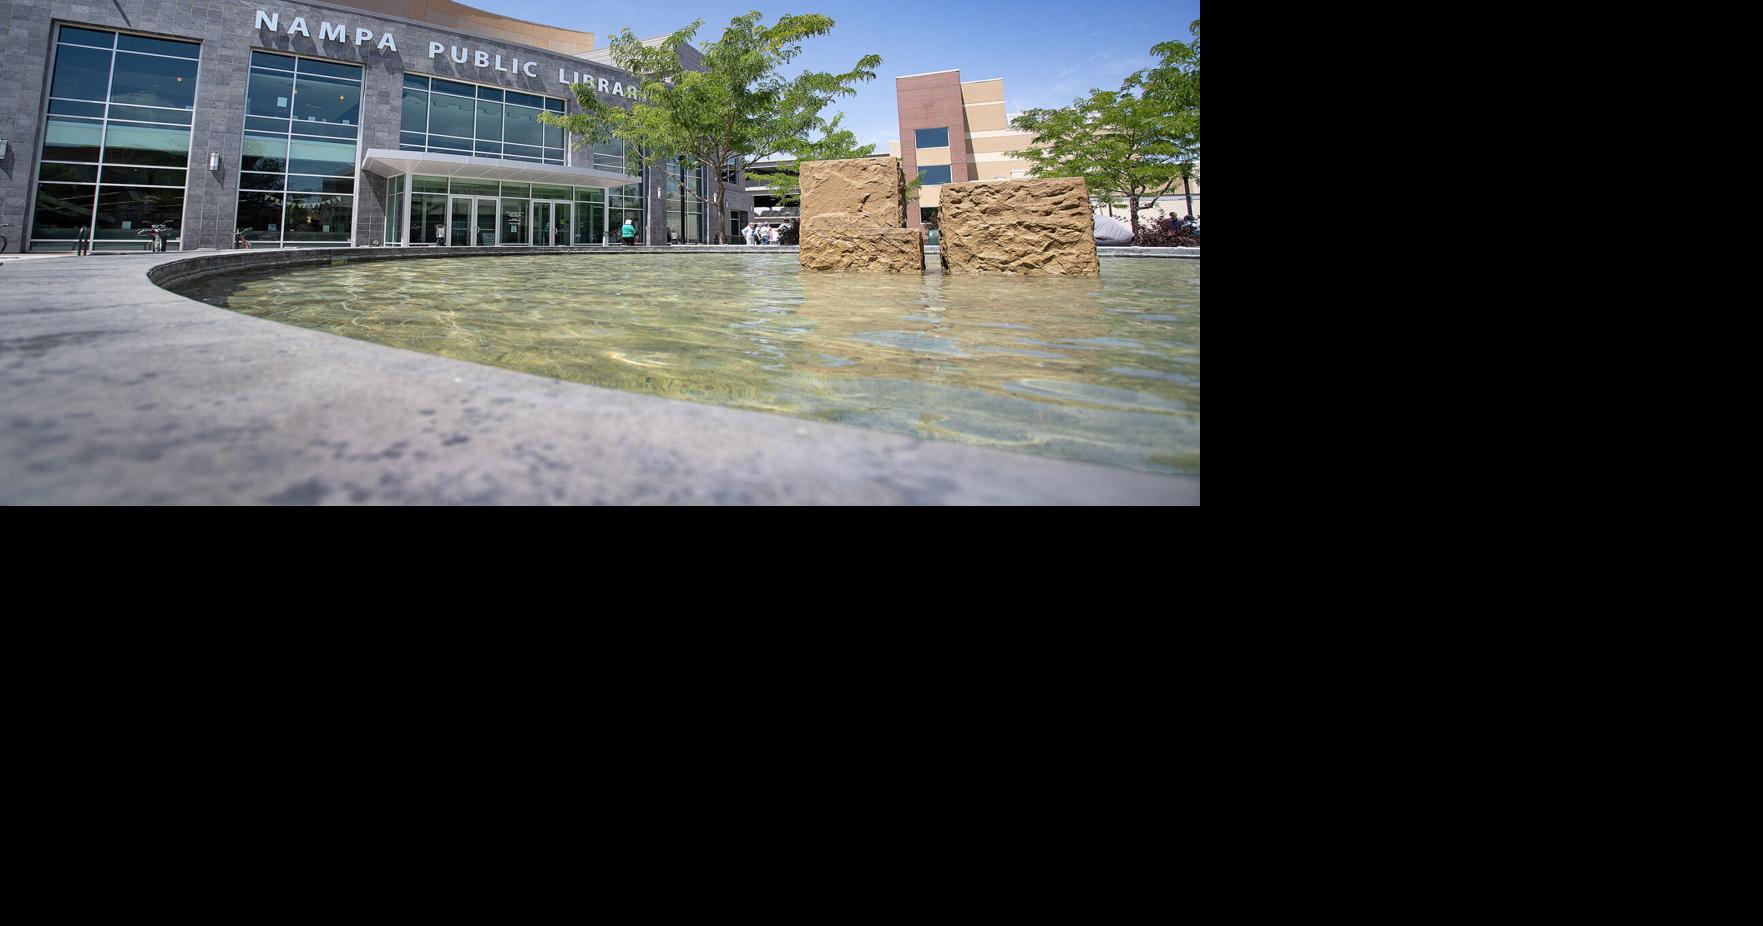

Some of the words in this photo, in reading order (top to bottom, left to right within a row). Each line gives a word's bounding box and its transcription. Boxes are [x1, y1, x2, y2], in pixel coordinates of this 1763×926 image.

[254, 10, 397, 52] NAMPA
[428, 42, 537, 78] PUBLIC
[559, 68, 649, 101] LIBRAR
